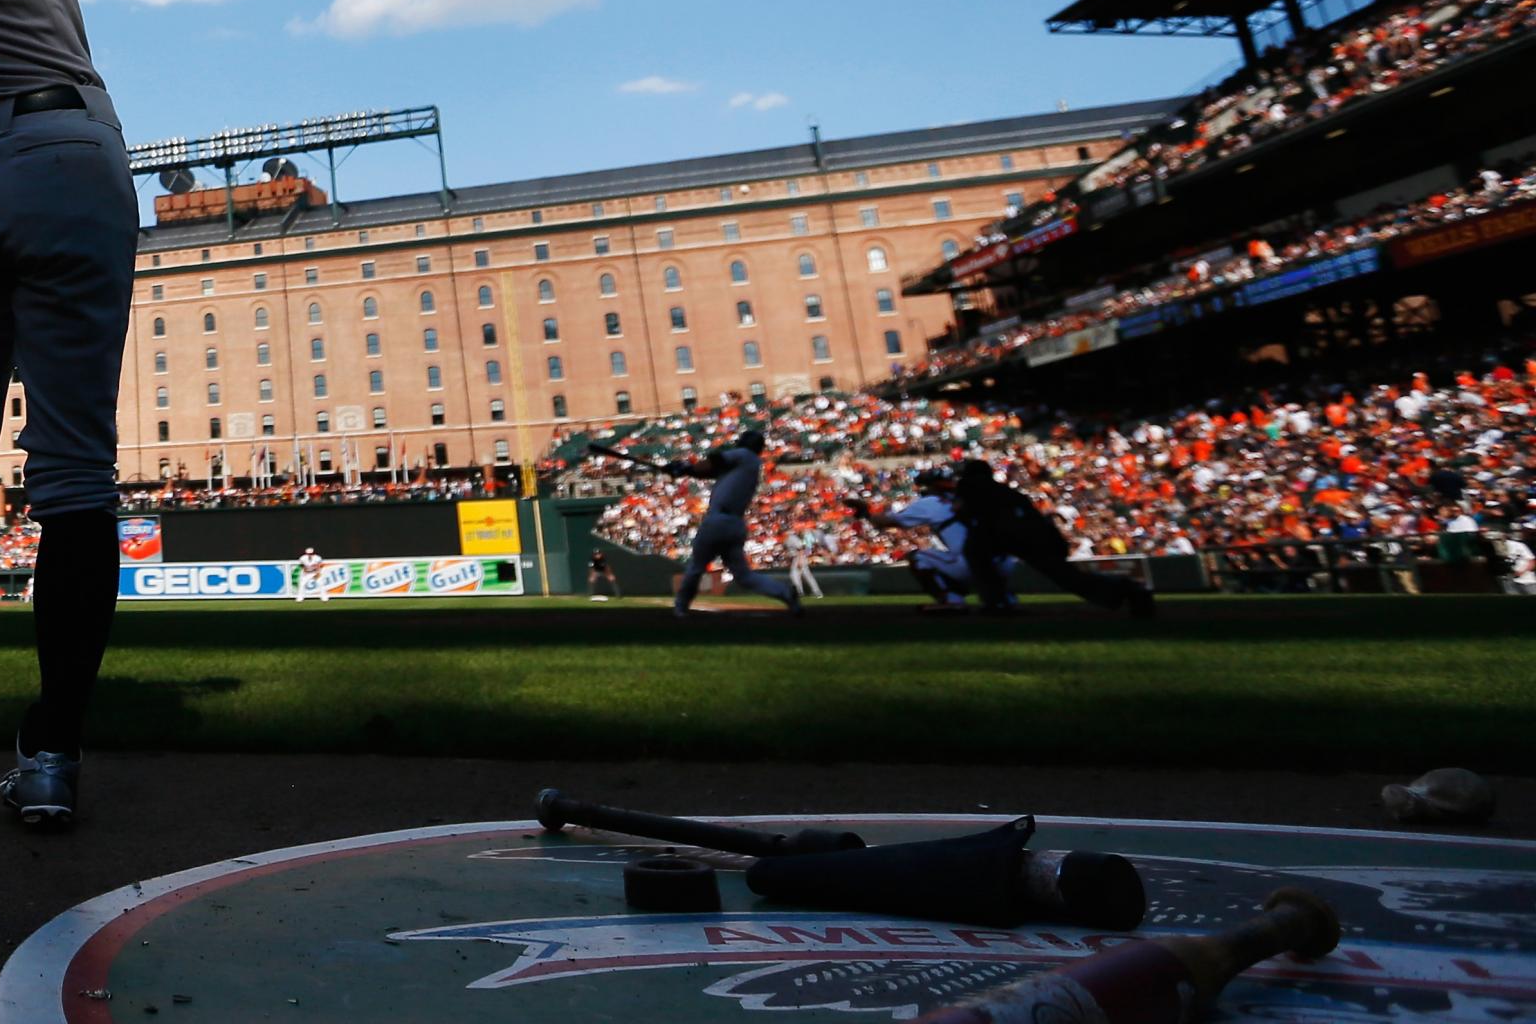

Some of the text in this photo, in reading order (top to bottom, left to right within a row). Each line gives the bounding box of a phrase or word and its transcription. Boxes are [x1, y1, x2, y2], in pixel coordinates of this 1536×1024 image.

[134, 566, 262, 595] GEICO
[366, 564, 411, 591] Gulf
[431, 563, 477, 589] Gulf
